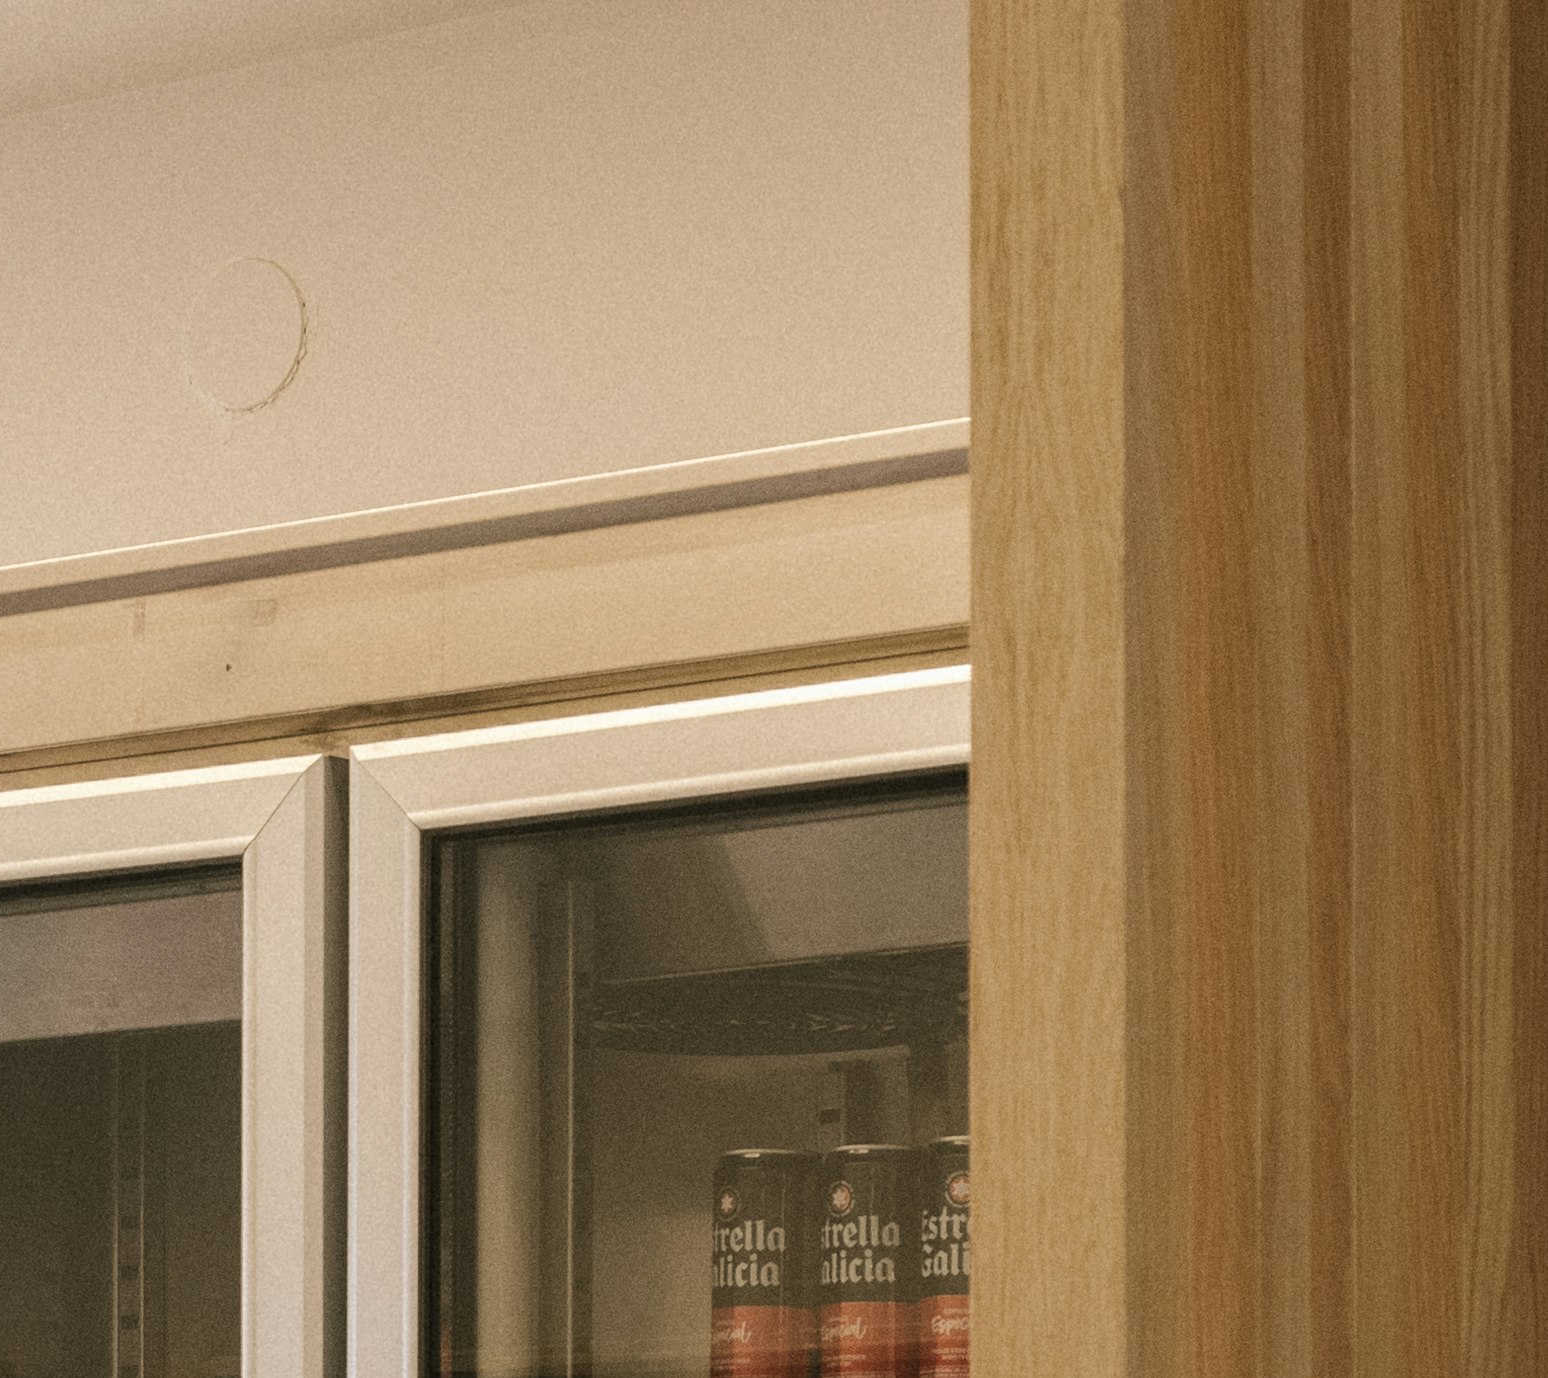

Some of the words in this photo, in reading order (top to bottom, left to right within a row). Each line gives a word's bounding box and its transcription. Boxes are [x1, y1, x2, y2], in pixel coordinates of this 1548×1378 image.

[712, 1219, 787, 1252] trella
[820, 1214, 901, 1249] trella
[712, 1254, 780, 1288] licia
[821, 1248, 897, 1285] alicia
